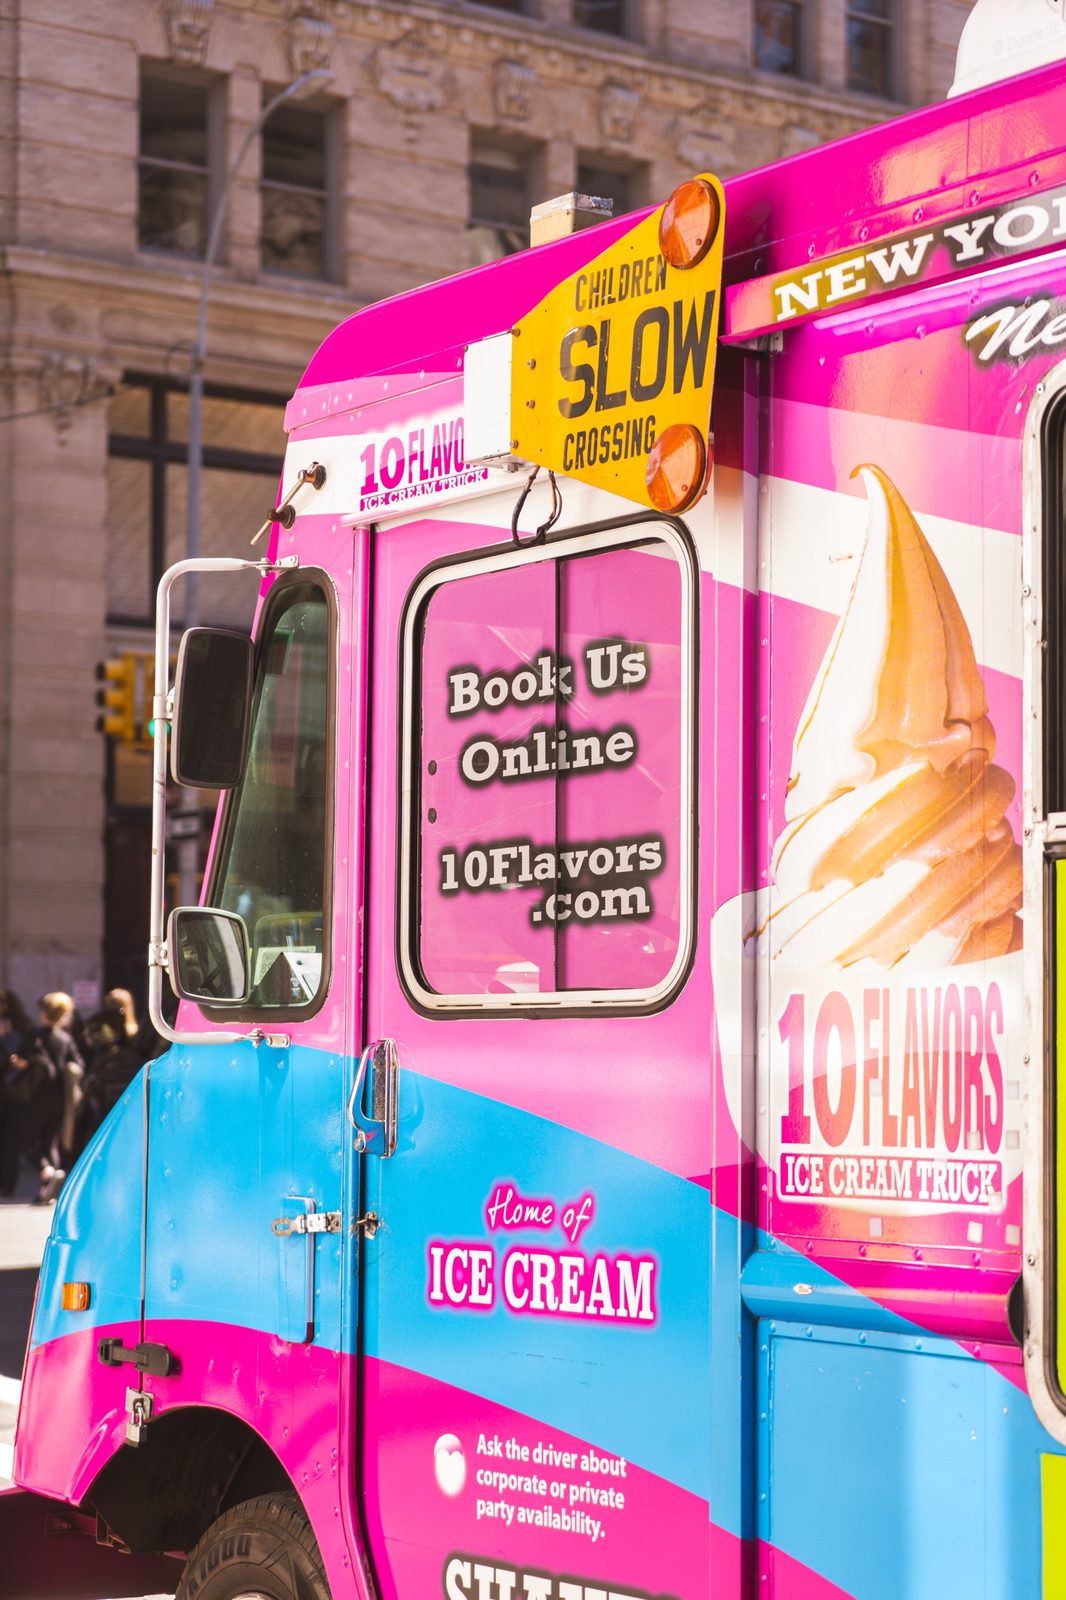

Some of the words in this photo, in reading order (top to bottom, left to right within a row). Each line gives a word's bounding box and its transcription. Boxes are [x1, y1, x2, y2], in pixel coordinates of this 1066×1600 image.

[575, 255, 668, 312] CHILDREN
[775, 233, 934, 322] NEW
[943, 196, 1066, 263] YO
[558, 290, 716, 419] SLOW
[563, 415, 656, 472] CROSSING
[362, 495, 386, 510] ICE
[388, 482, 436, 503] CREAM
[439, 469, 485, 491] TRUCK
[450, 656, 572, 713] Book
[586, 644, 647, 689] Us
[462, 730, 634, 782] Online
[441, 841, 662, 890] 10Flavors
[533, 885, 650, 922] .com
[785, 1156, 824, 1194] ICE
[829, 1157, 912, 1199] CREAM
[916, 1162, 998, 1204] TRUCK
[488, 1188, 553, 1228] Home
[563, 1197, 592, 1242] of
[430, 1247, 493, 1304] ICE
[504, 1251, 654, 1320] CREAM
[476, 1434, 502, 1458] Ask
[505, 1437, 530, 1461] the
[532, 1441, 577, 1469] driver
[580, 1449, 627, 1478] about
[476, 1468, 547, 1496] corporate
[550, 1481, 566, 1498] or
[569, 1481, 625, 1509] private
[476, 1498, 514, 1526] party
[517, 1505, 605, 1542] availability.
